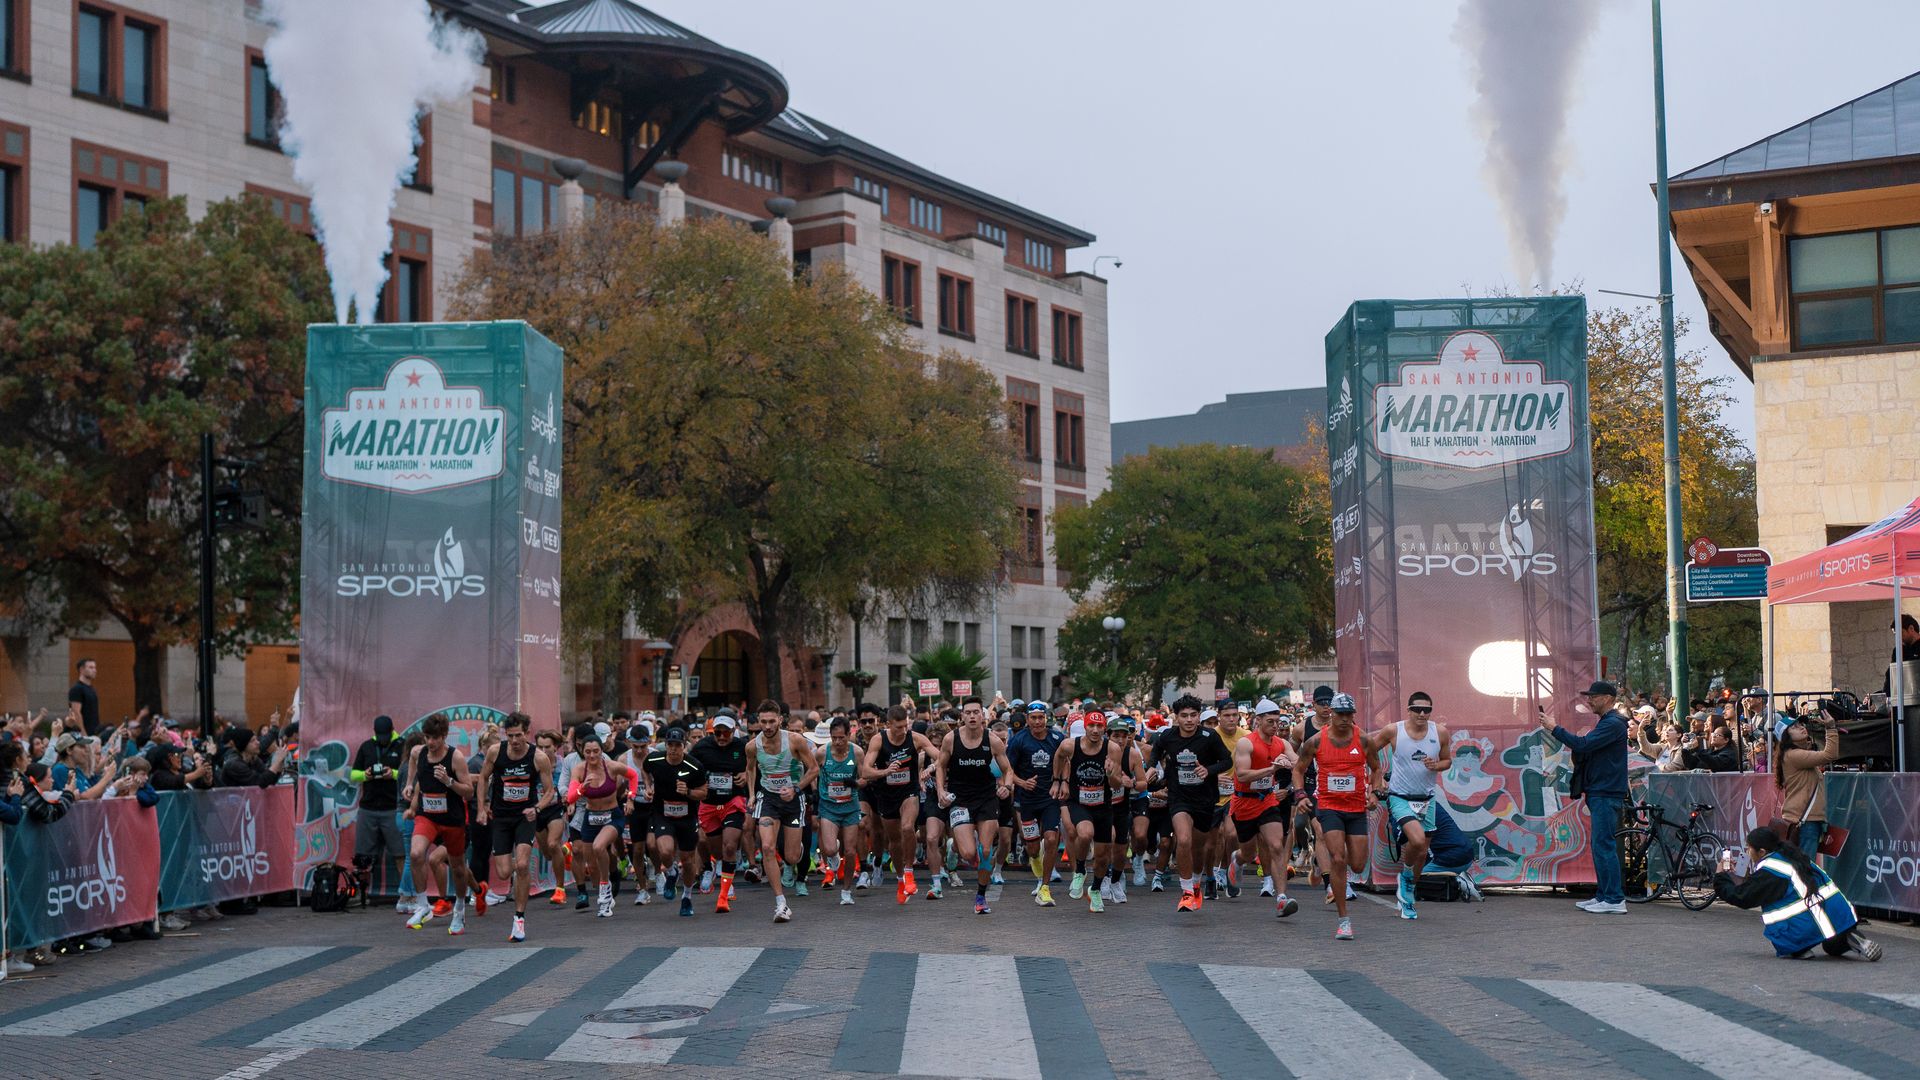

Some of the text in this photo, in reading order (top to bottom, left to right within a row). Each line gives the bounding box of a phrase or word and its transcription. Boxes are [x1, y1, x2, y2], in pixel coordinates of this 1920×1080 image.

[1409, 372, 1533, 384] SAN ANTONIO
[355, 397, 473, 410] SAN ANTONIO
[1380, 392, 1564, 433] MARATHON
[328, 418, 500, 456] MARATHON
[1410, 435, 1537, 447] HALF MARATHON MARATHON
[354, 459, 473, 471] HALF MARATHON MARATHON
[1401, 541, 1495, 551] SAN ANTONIO
[341, 563, 430, 573] SAN ANTONIO
[1398, 552, 1557, 577] SPORTS
[1824, 553, 1871, 578] SPORTS
[337, 574, 486, 597] SPORTS
[958, 758, 987, 767] balega
[1867, 838, 1884, 850] SAN
[200, 851, 270, 883] SPORTS
[47, 875, 126, 917] SPORTS
